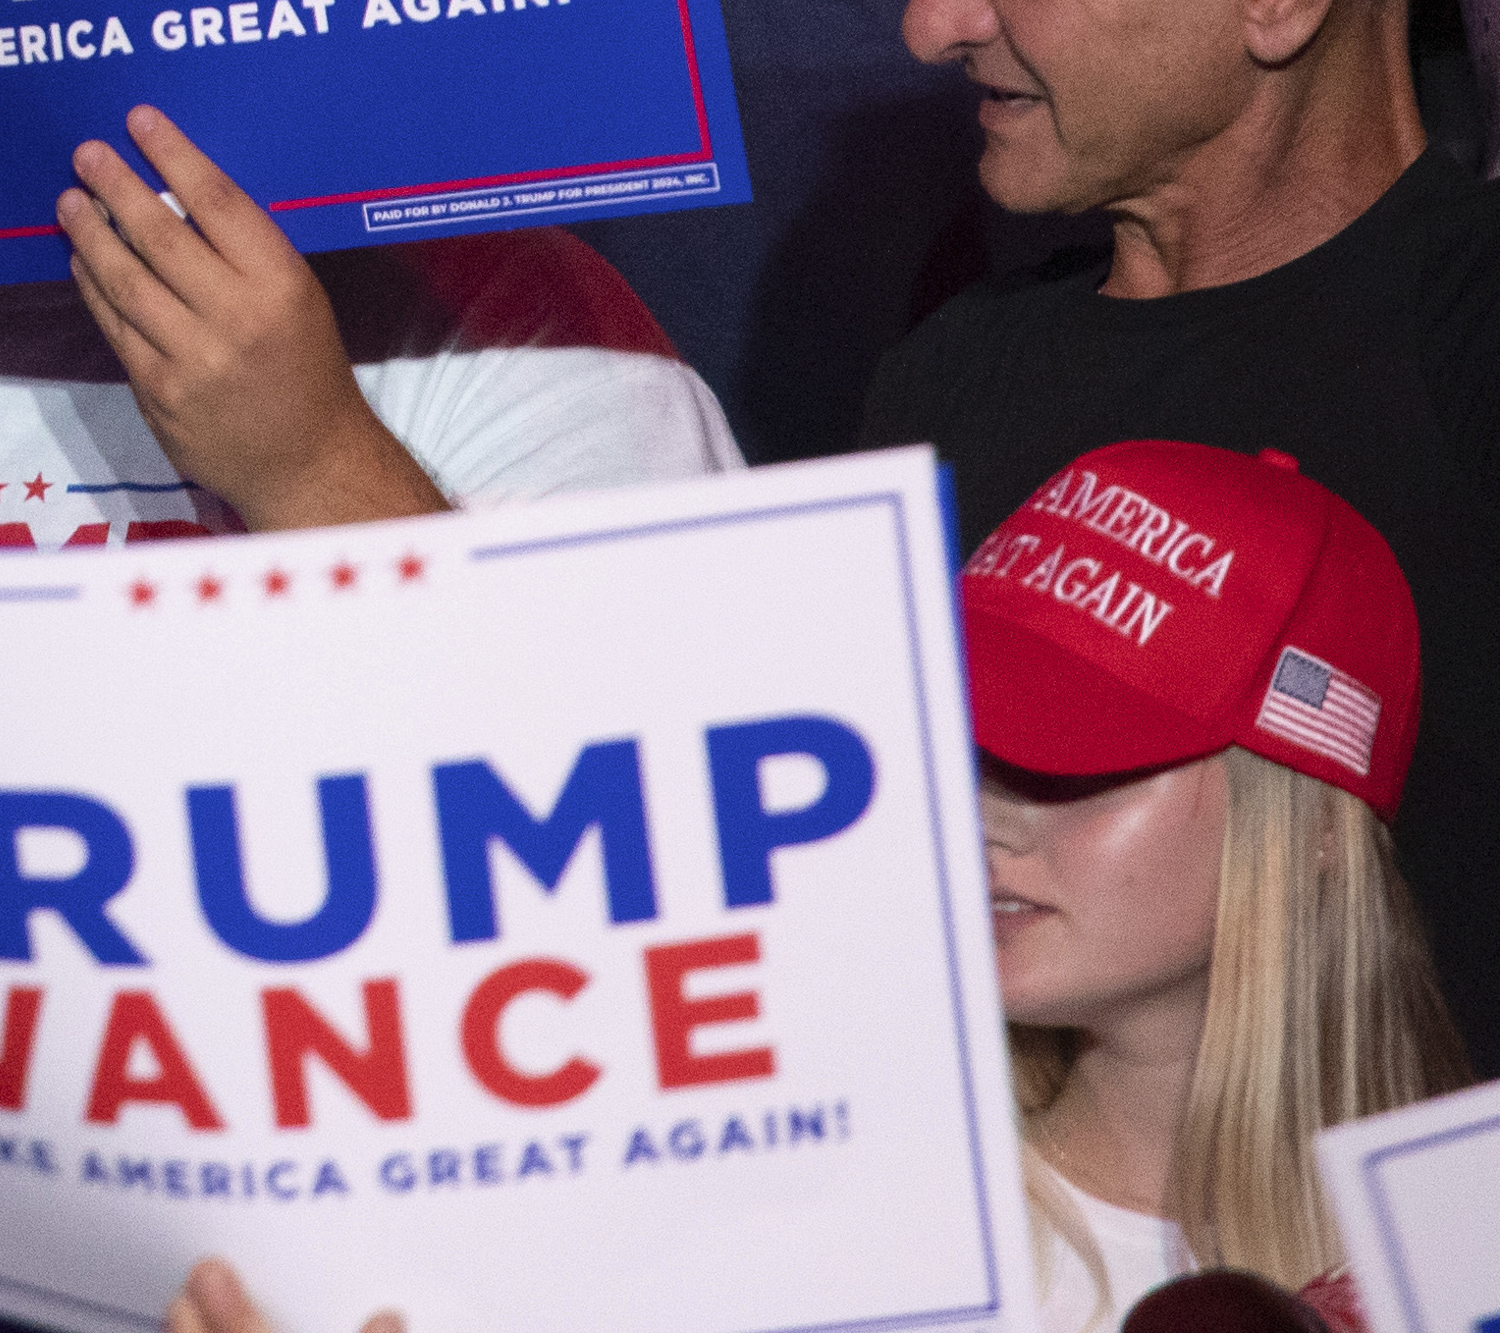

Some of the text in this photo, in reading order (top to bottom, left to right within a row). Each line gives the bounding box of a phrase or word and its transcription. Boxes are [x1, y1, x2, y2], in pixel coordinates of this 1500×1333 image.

[374, 208, 402, 222] PAID
[405, 205, 429, 219] FOR
[431, 203, 447, 215] BY
[514, 190, 556, 206] TRUMP
[558, 187, 583, 201] FOR
[1034, 467, 1235, 598] AMERICA
[1022, 544, 1174, 647] AGAIN
[83, 1151, 350, 1203] AMERICA
[378, 1132, 594, 1194] GREAT
[622, 1099, 854, 1167] AGAIN!
